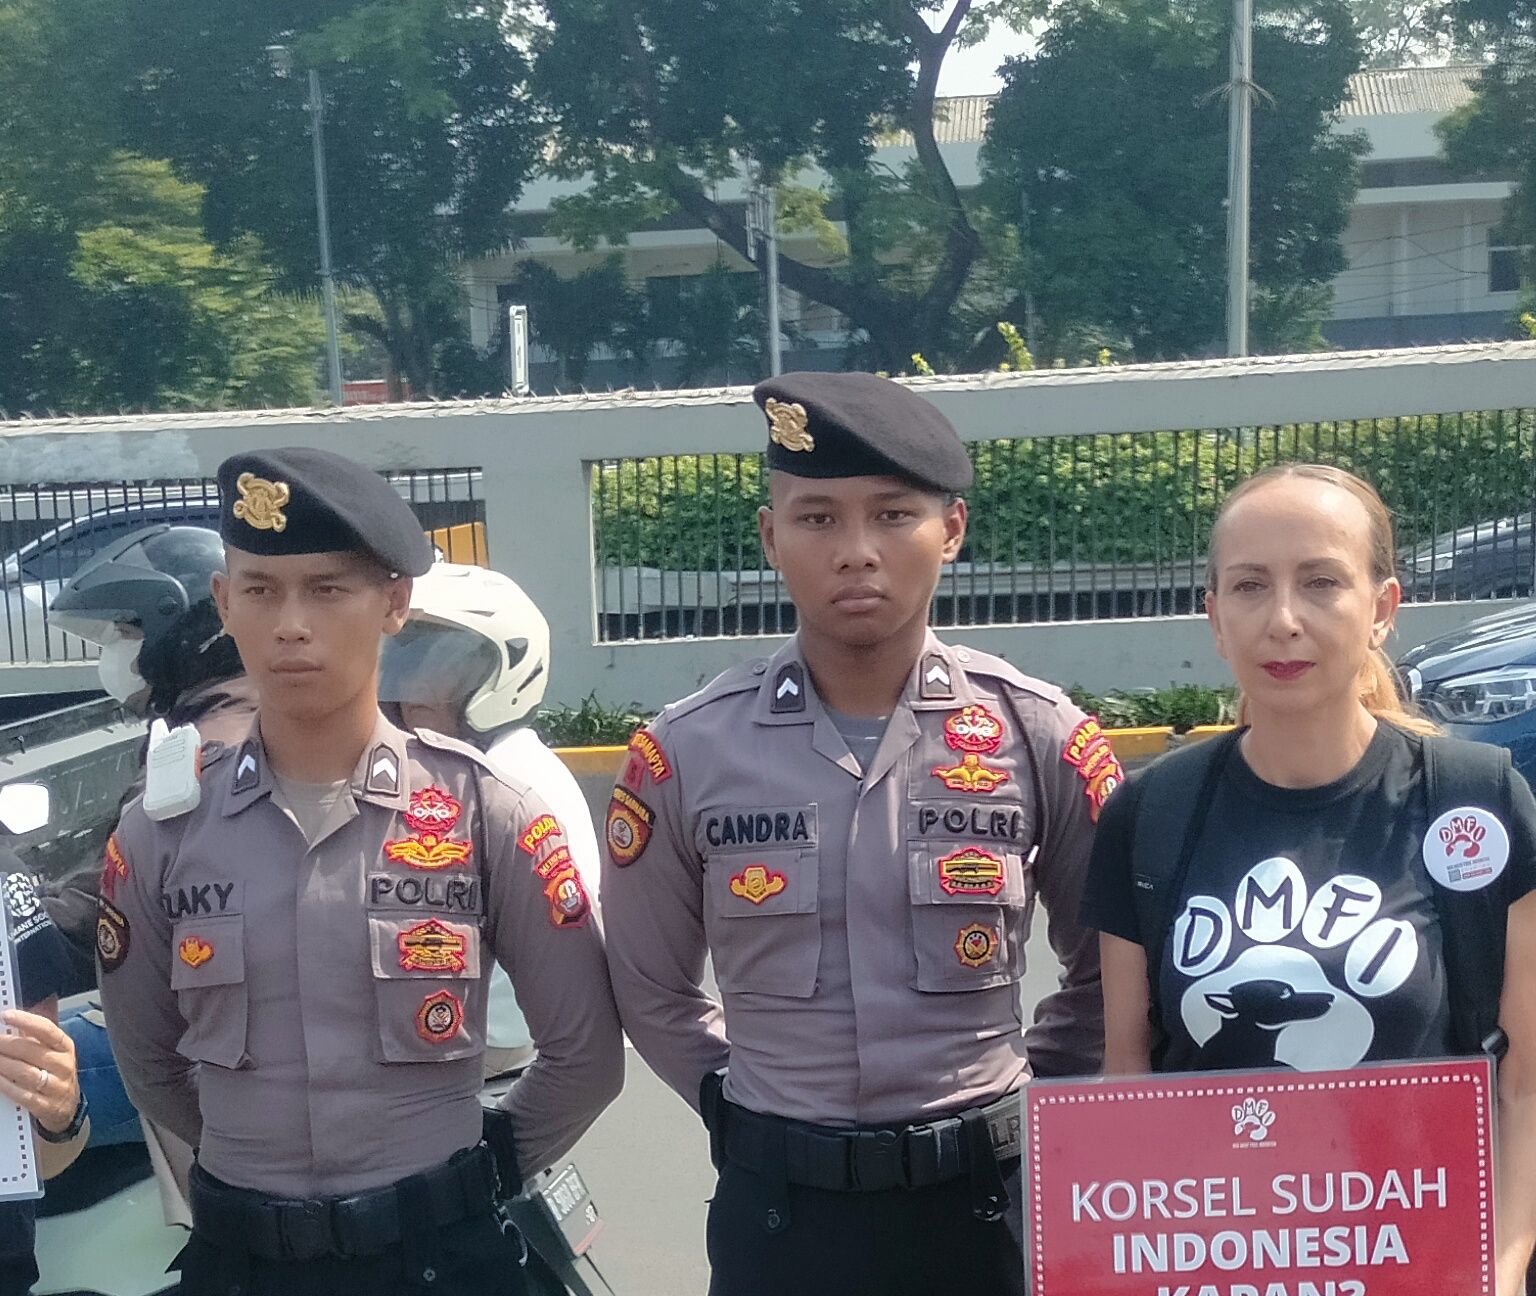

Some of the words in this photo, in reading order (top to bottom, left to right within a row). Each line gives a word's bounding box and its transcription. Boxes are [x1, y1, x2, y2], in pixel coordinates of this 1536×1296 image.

[706, 811, 808, 847] CANDRA
[920, 807, 1021, 839] POLRI
[371, 877, 477, 911] POLRI
[1180, 875, 1403, 985] DMFI
[1234, 1100, 1273, 1124] DMFI
[1071, 1176, 1256, 1223] KORSEL
[1272, 1166, 1447, 1215] SUDAH
[1113, 1224, 1410, 1273] INDONESIA
